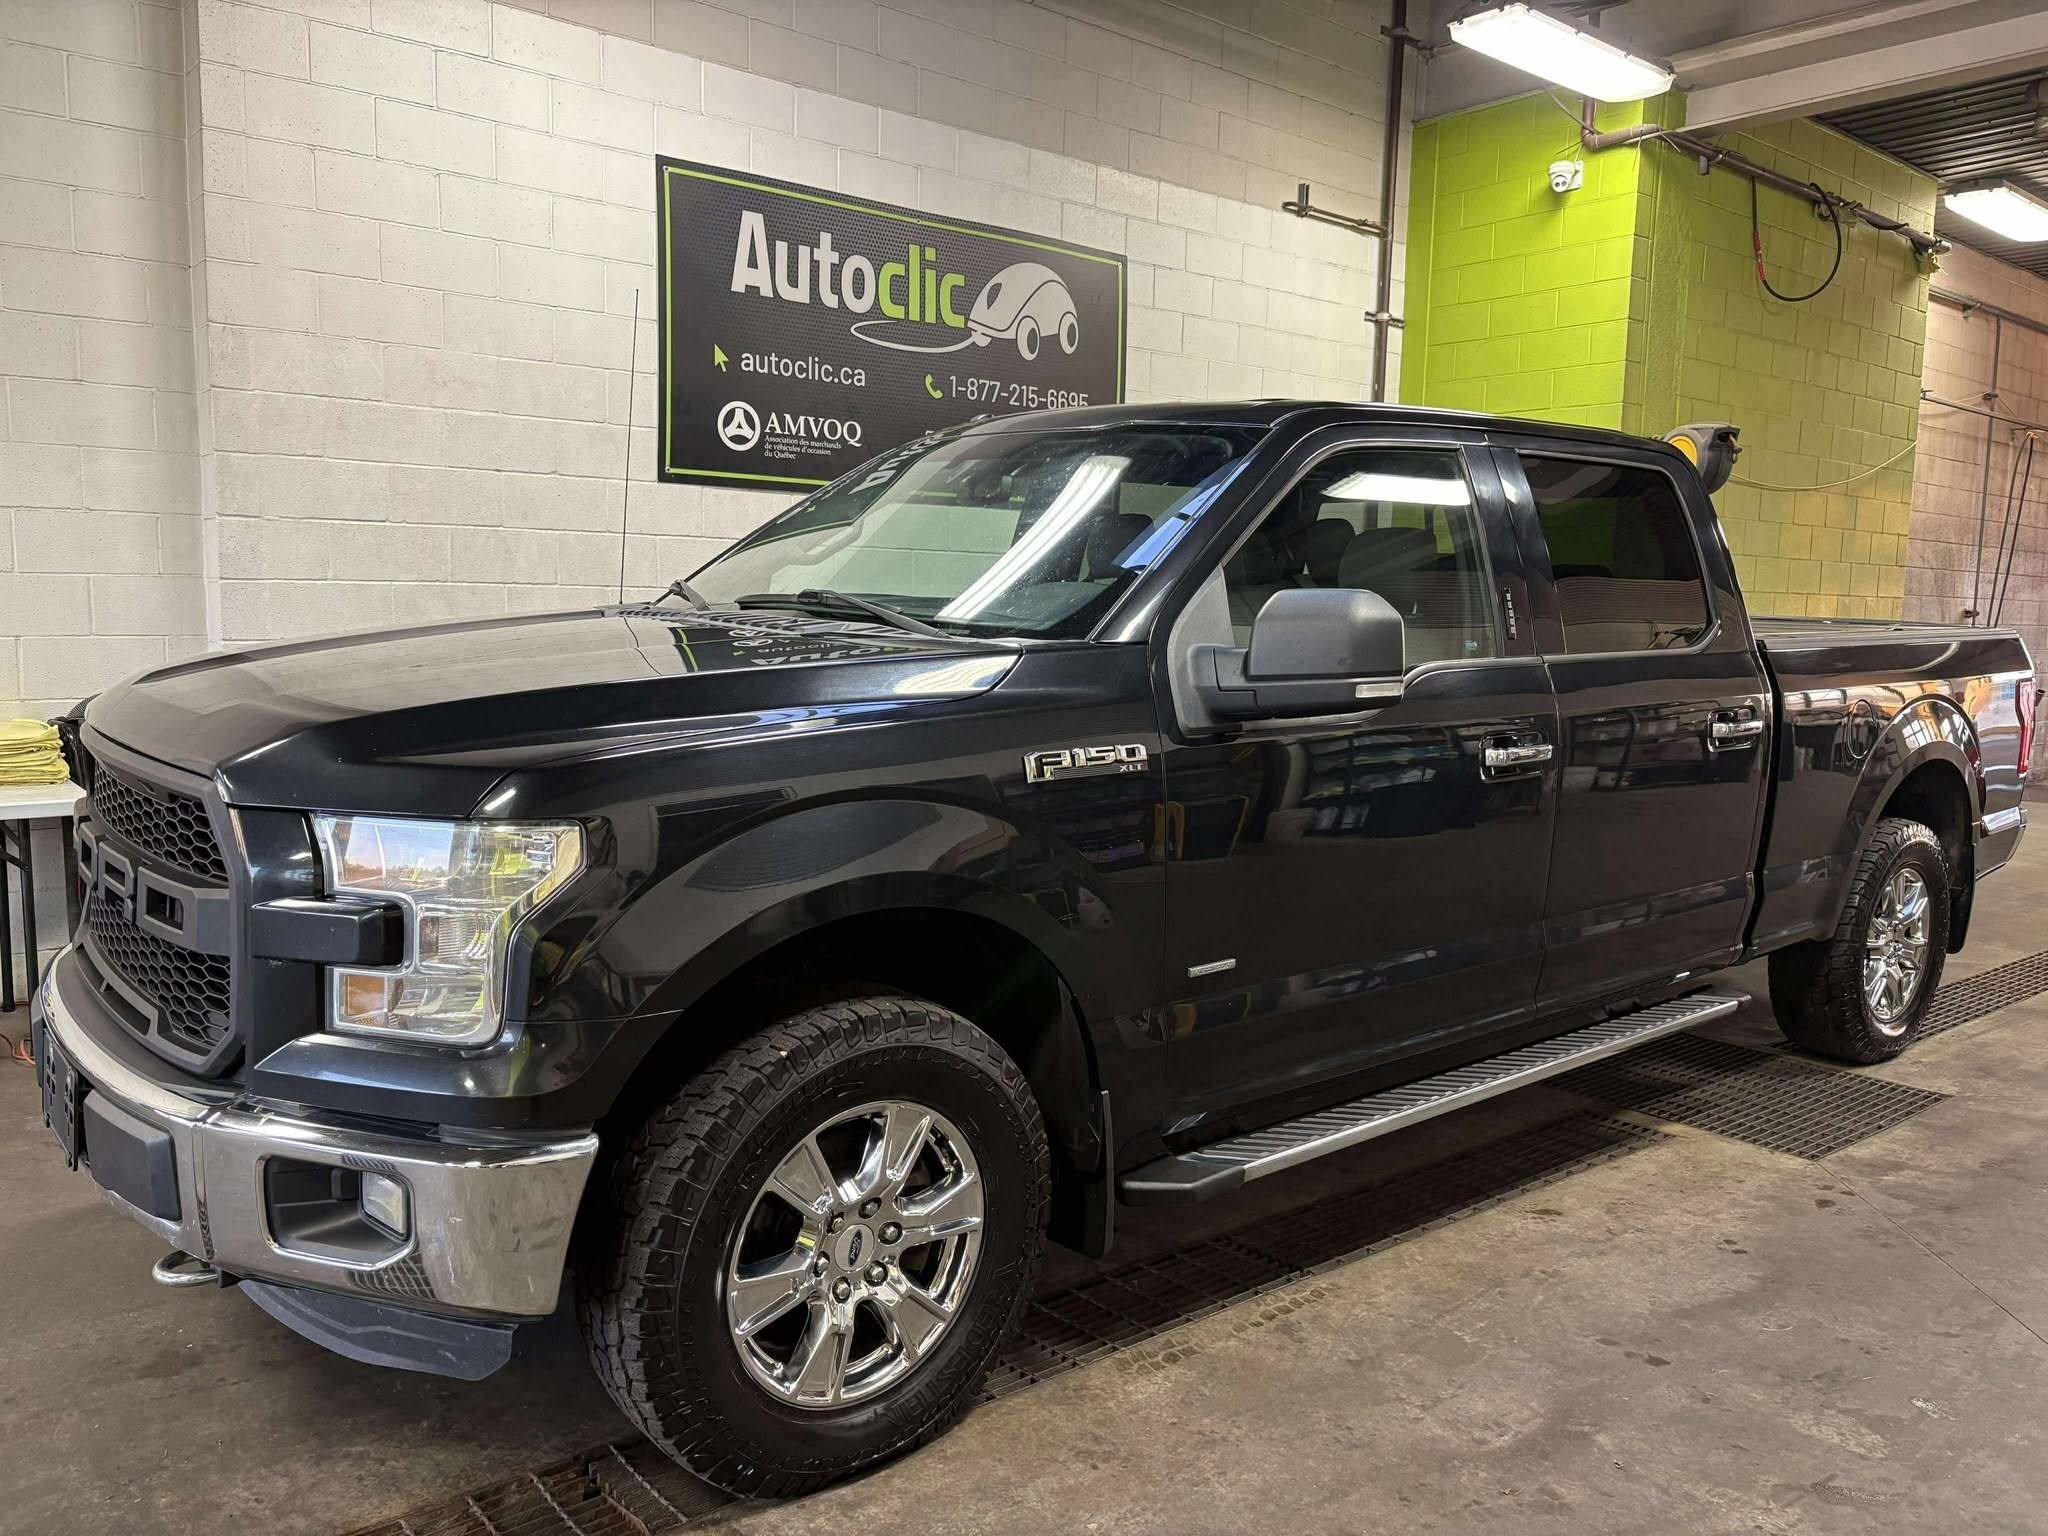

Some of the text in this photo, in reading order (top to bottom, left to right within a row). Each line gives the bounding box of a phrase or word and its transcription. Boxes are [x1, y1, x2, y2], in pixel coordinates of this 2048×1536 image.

[730, 209, 966, 329] Autoclic
[740, 352, 866, 387] autoclic.ca
[949, 375, 1089, 409] 1-877-215-6695
[764, 411, 862, 447] AMVOQ
[764, 435, 841, 449] Association des marchands
[764, 442, 772, 450] de
[764, 449, 796, 460] du Québec
[1119, 763, 1144, 773] XLT
